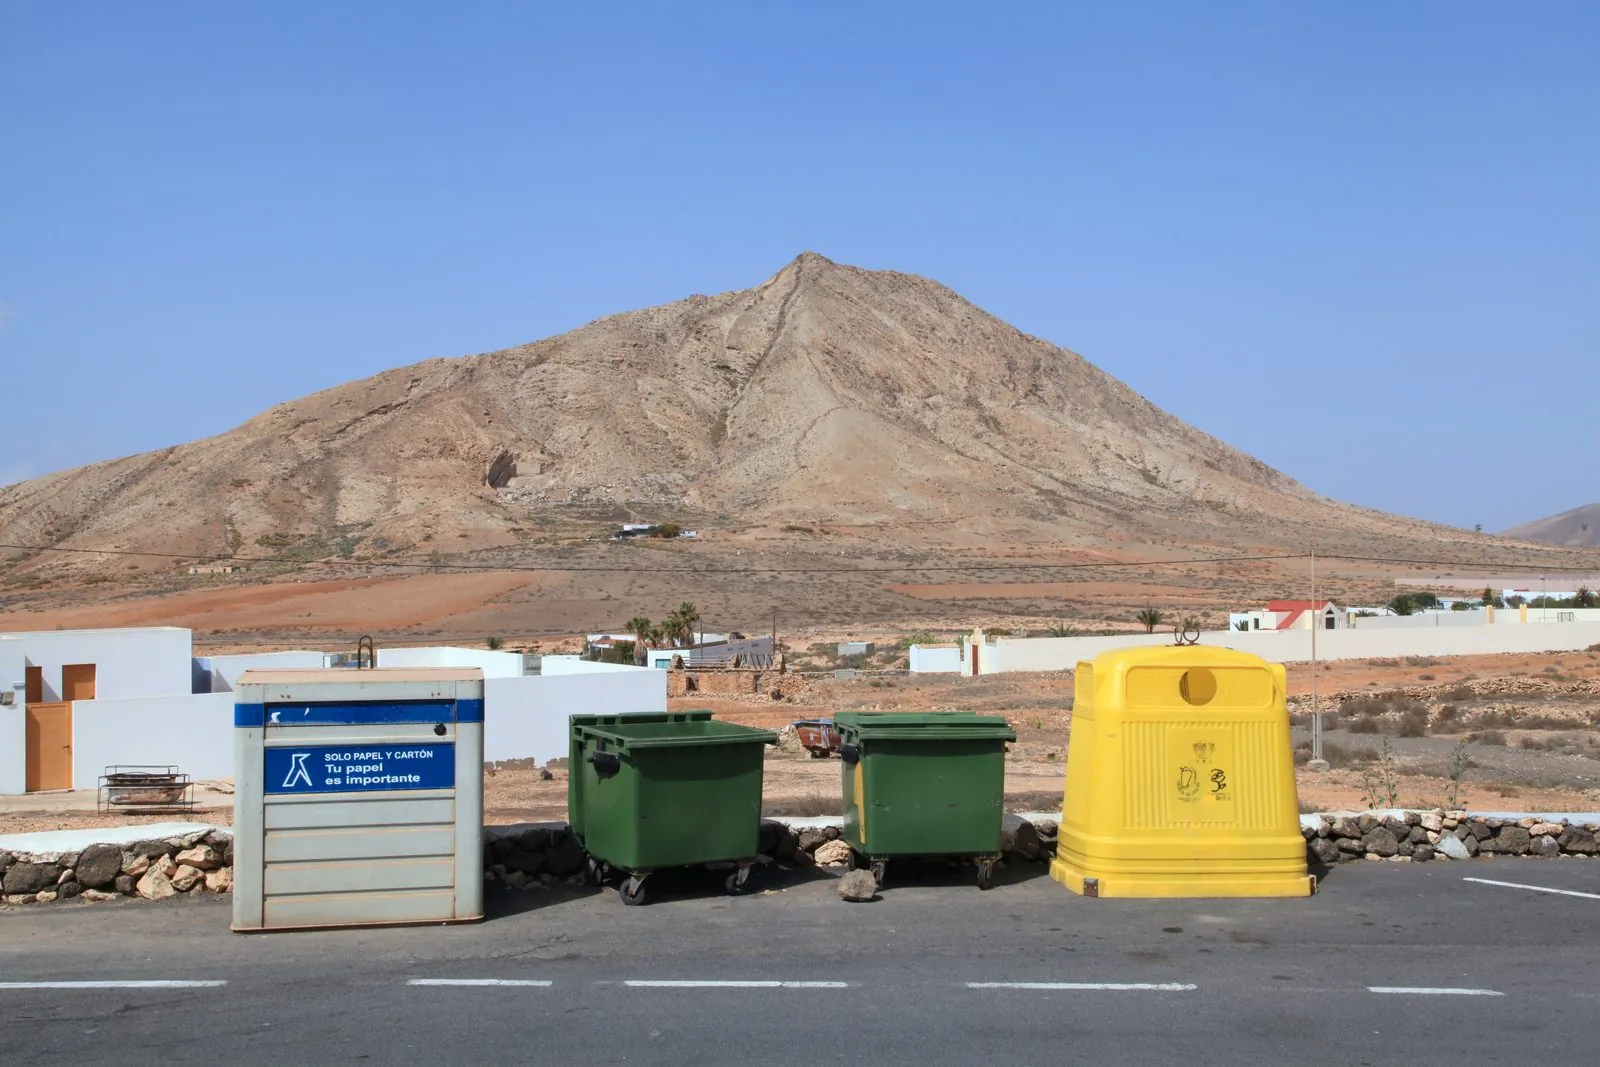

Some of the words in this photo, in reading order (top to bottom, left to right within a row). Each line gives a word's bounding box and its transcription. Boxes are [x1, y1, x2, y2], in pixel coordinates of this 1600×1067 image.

[324, 753, 351, 761] SOLO
[353, 752, 383, 761] PAPEL
[385, 751, 392, 759] Y
[394, 749, 433, 759] CARTÓN
[325, 764, 341, 773] Tu
[346, 763, 383, 774] papel
[325, 777, 341, 785] es
[346, 774, 420, 786] importante
